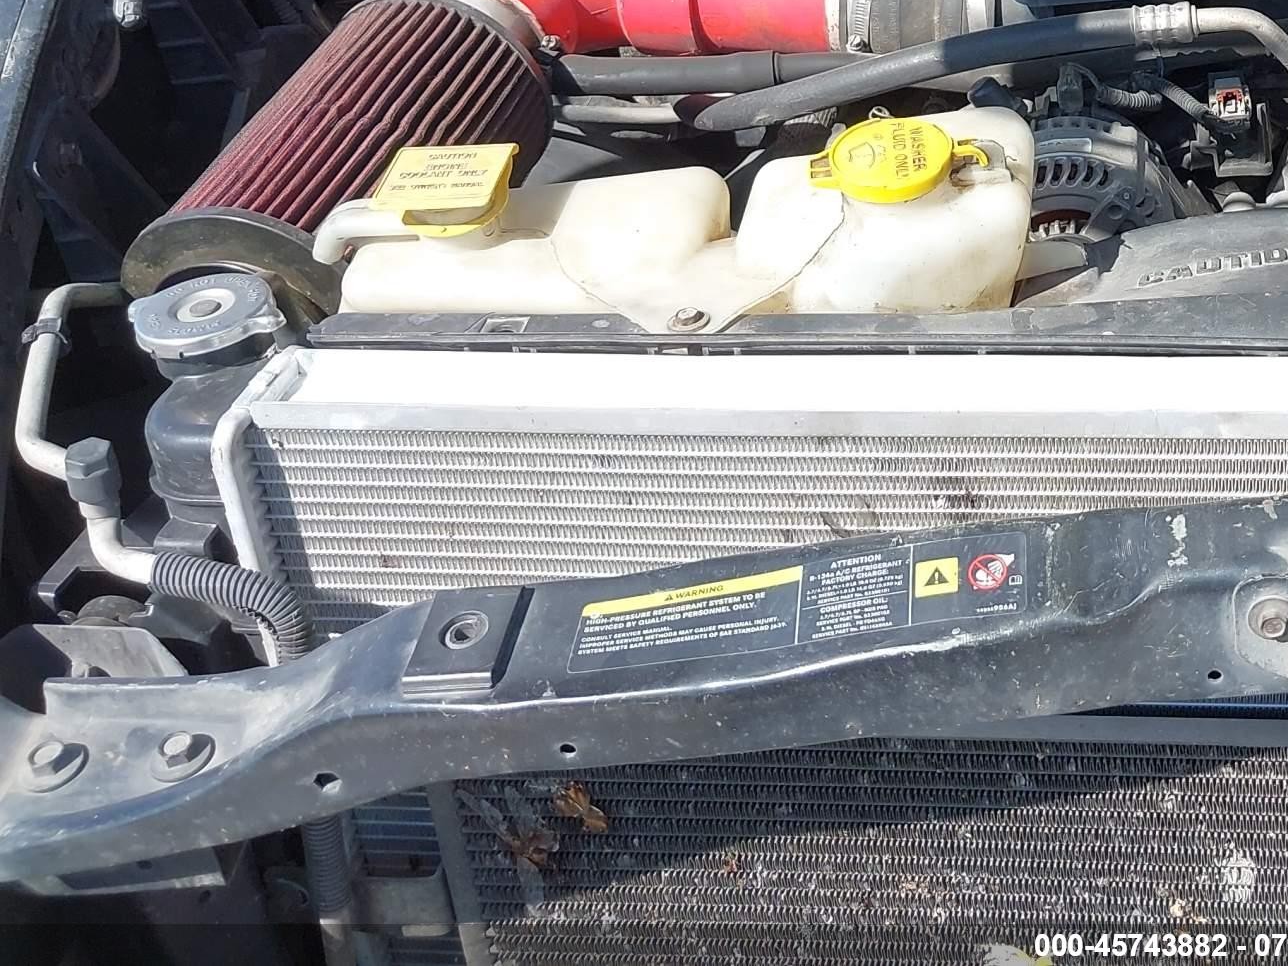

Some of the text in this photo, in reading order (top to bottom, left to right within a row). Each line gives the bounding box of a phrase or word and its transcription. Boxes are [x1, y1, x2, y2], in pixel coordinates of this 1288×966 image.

[888, 122, 907, 151] FLUID
[428, 152, 478, 161] CAUTION
[909, 125, 928, 173] WASHER
[399, 169, 489, 179] COOLANT ONLY
[830, 553, 882, 569] ATTENTION
[836, 567, 851, 576] A/C
[852, 560, 902, 573] REFRIGERANT
[821, 575, 855, 585] FACTORY
[856, 569, 889, 579] CHARGE:
[675, 585, 724, 599] WARNING
[586, 611, 651, 625] HIGH-PRESSURE
[652, 601, 707, 616] REFRIGERANT
[708, 597, 741, 607] SYSTEM
[819, 600, 872, 614] COMPRESSOR
[584, 623, 624, 633] SERVICED
[638, 616, 681, 626] QUALIFIED
[683, 607, 731, 619] PERSONNEL
[733, 601, 757, 611] ONLY.
[578, 647, 605, 655] SYSTEM
[606, 644, 628, 652] MEETS
[629, 641, 655, 650] SAFETY
[655, 631, 708, 645] REQUIREMENTS
[733, 625, 769, 635] STANDARD
[579, 639, 615, 648] IMPROPER
[615, 636, 644, 645] SERVICE
[694, 625, 716, 633] CAUSE
[717, 621, 753, 630] PERSONAL
[581, 634, 612, 643] CONSULT
[613, 631, 642, 639] SERVICE
